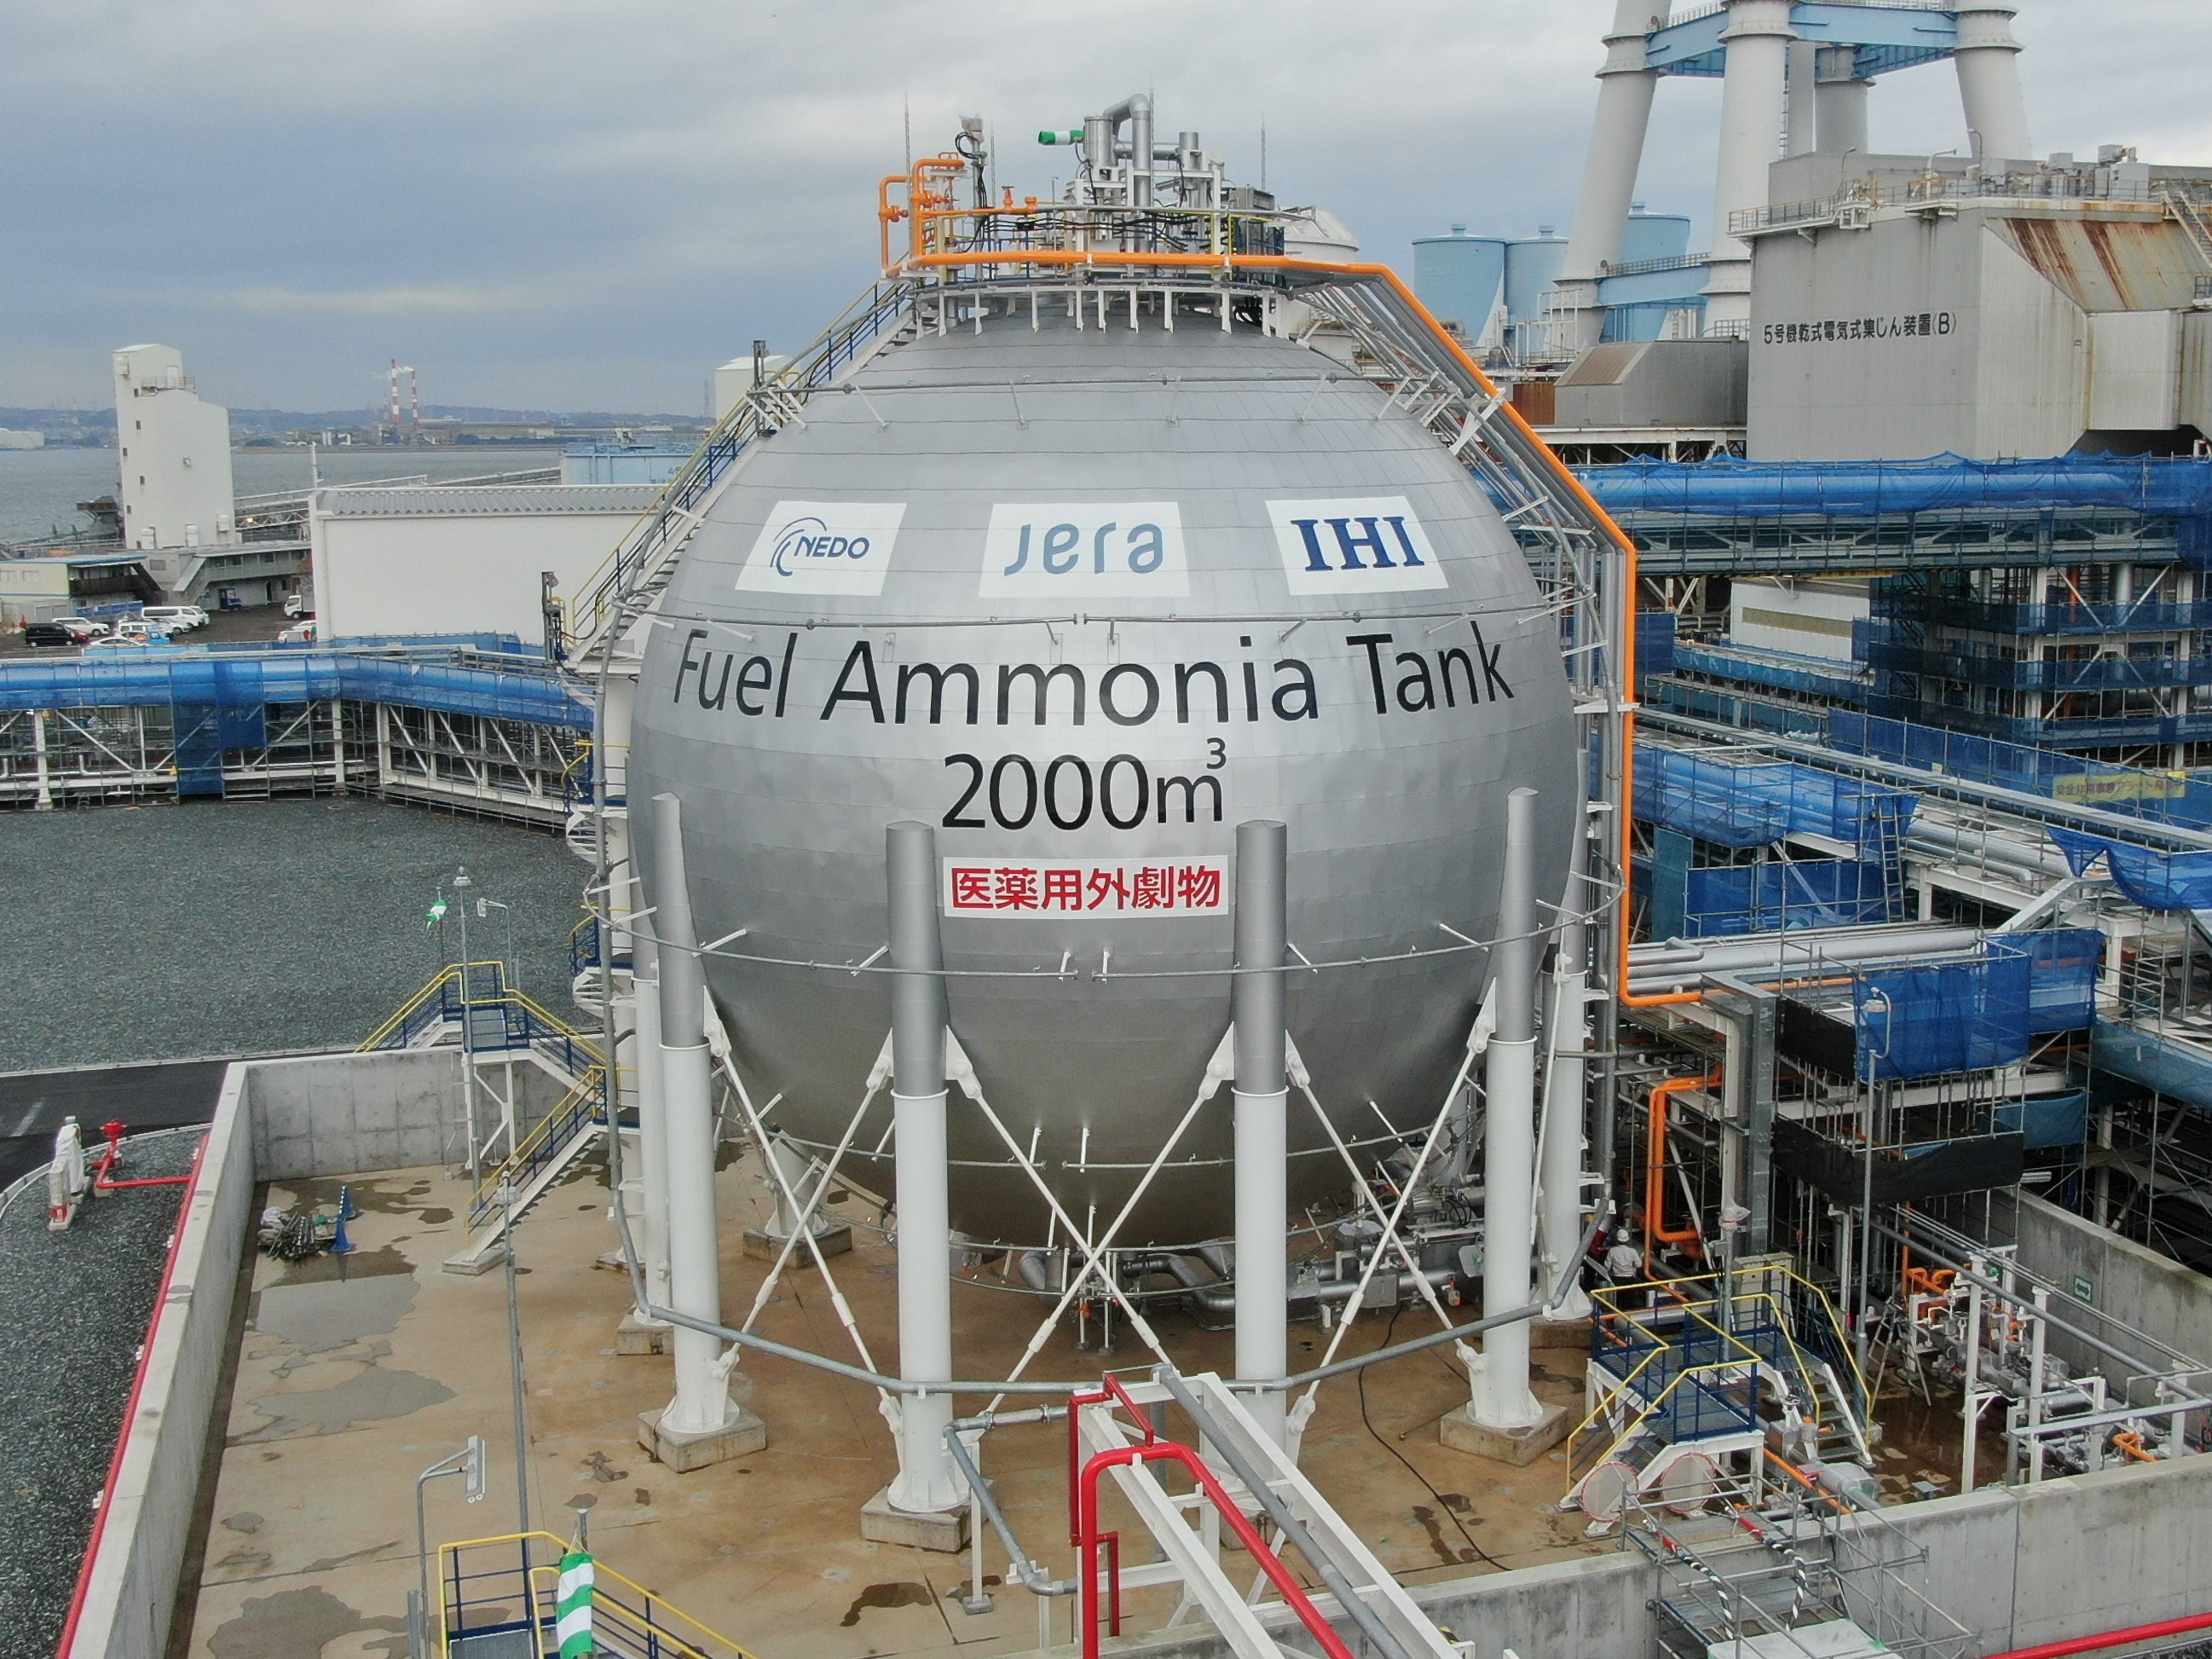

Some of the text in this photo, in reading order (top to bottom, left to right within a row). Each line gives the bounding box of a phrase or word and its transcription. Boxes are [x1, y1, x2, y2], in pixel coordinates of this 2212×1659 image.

[1764, 312, 1957, 344] 5号機乾式電気式集じん装置(B)
[793, 535, 870, 560] NEDO
[1290, 515, 1426, 572] IHI
[673, 620, 1515, 727] Fuel Ammonia Tank
[951, 864, 1222, 911] 医薬用外劇物
